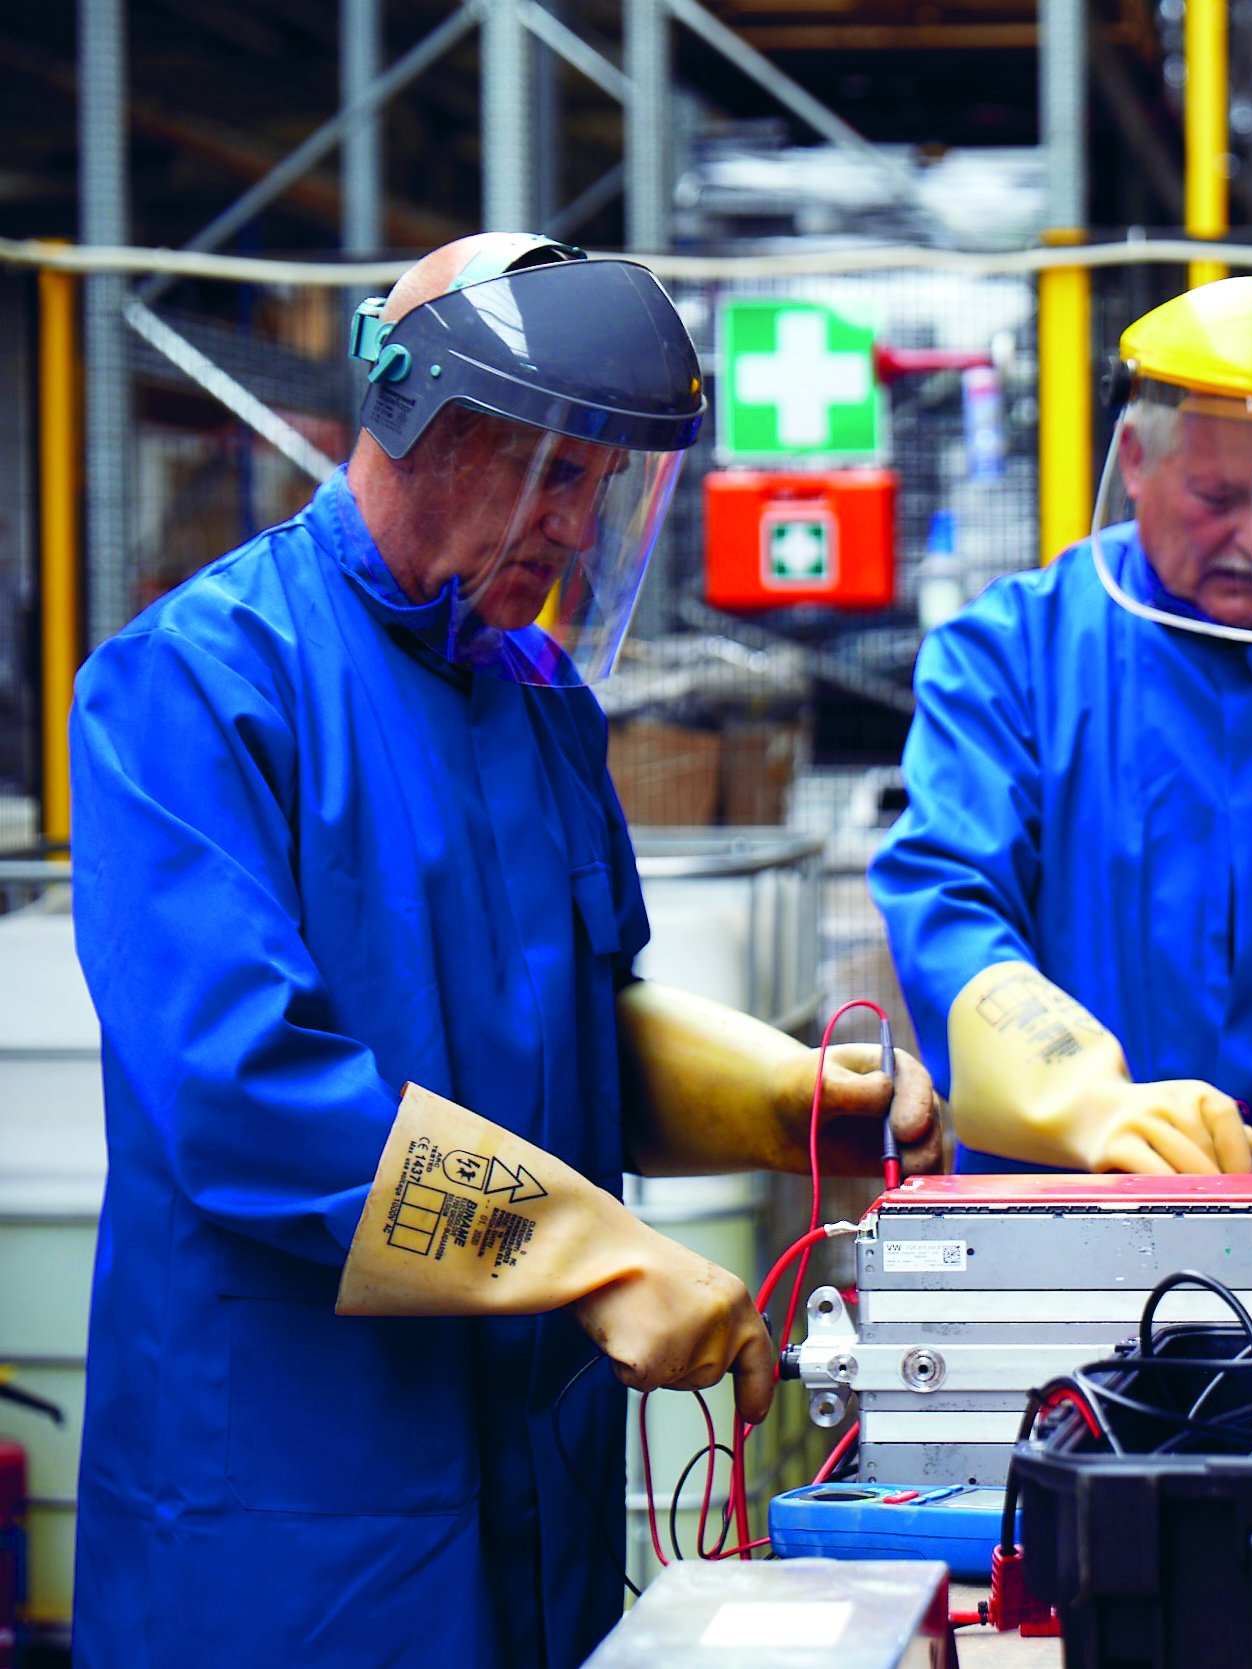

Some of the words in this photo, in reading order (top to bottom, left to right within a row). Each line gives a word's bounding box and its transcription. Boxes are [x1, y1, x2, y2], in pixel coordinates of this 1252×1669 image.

[407, 1153, 426, 1183] 1437
[425, 1144, 437, 1172] TESTED
[433, 1152, 443, 1168] ARC
[453, 1199, 478, 1247] BINAME
